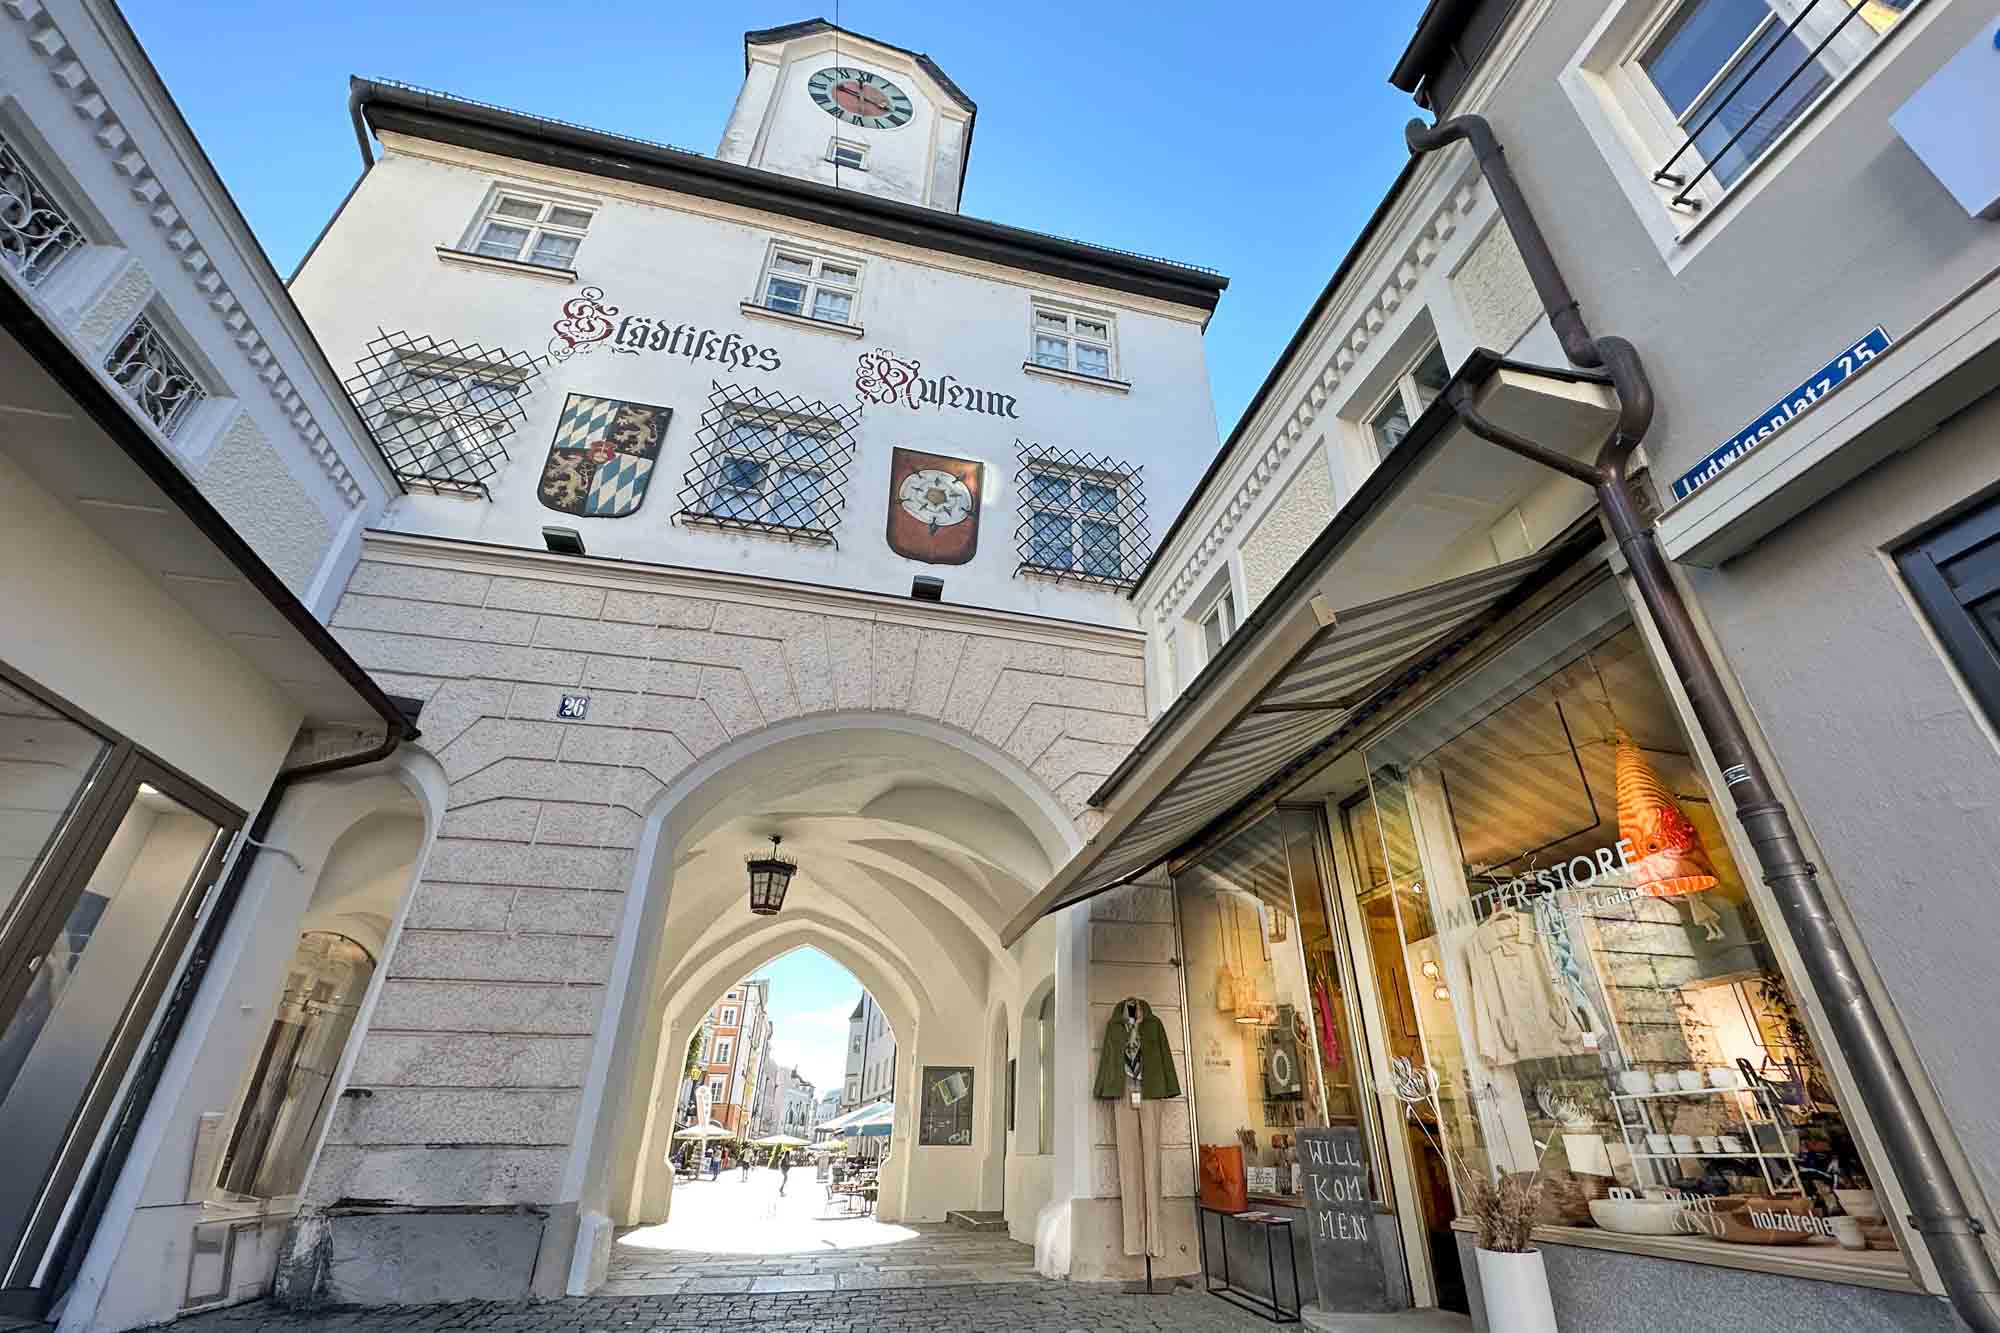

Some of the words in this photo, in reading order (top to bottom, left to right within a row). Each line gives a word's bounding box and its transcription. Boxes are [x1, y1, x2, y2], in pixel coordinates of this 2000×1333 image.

[1837, 342, 1876, 378] 25
[561, 697, 585, 717] 26
[1444, 878, 1533, 928] MTTER
[1536, 838, 1641, 901] STORE
[1304, 1139, 1361, 1168] WILL
[1308, 1173, 1364, 1202] KOM
[1319, 1209, 1368, 1242] MEN
